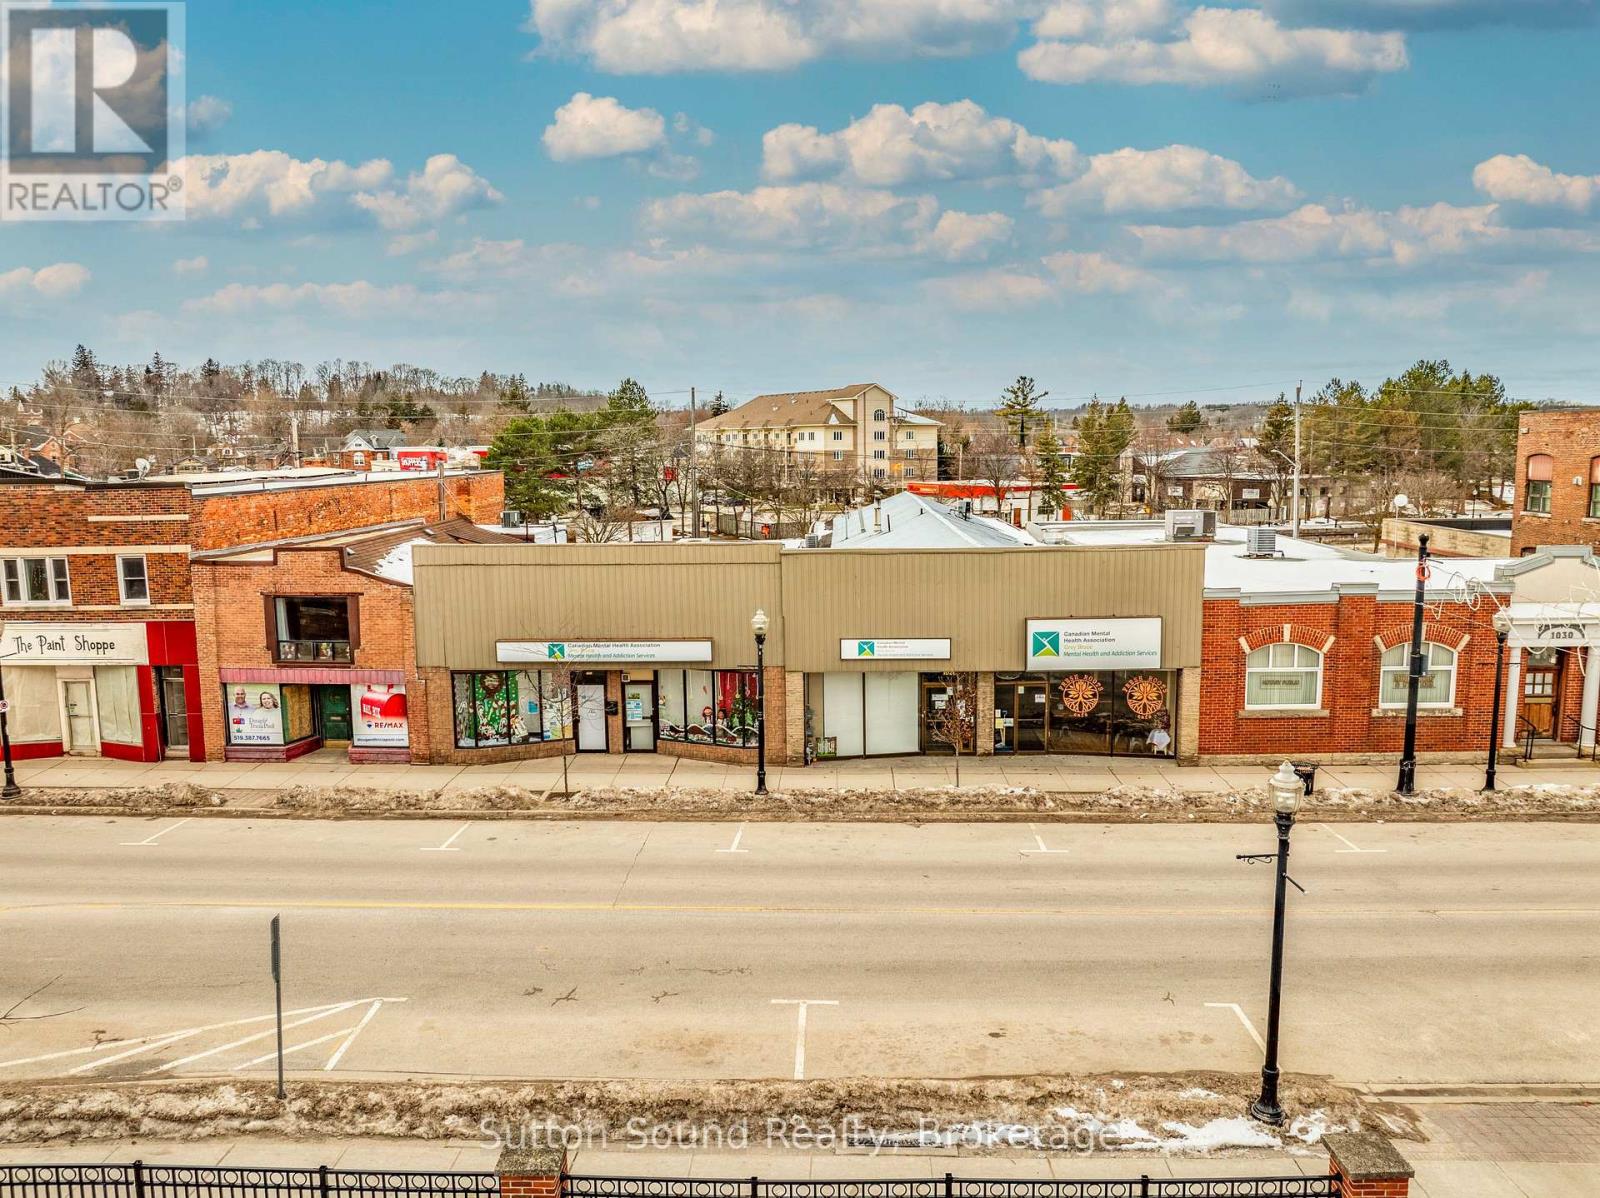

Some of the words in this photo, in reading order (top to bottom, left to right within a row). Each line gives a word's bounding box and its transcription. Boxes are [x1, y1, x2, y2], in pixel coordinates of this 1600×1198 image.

[1551, 631, 1574, 639] 1030
[12, 635, 33, 654] The
[36, 635, 65, 654] Paint
[75, 634, 115, 655] Shoppe
